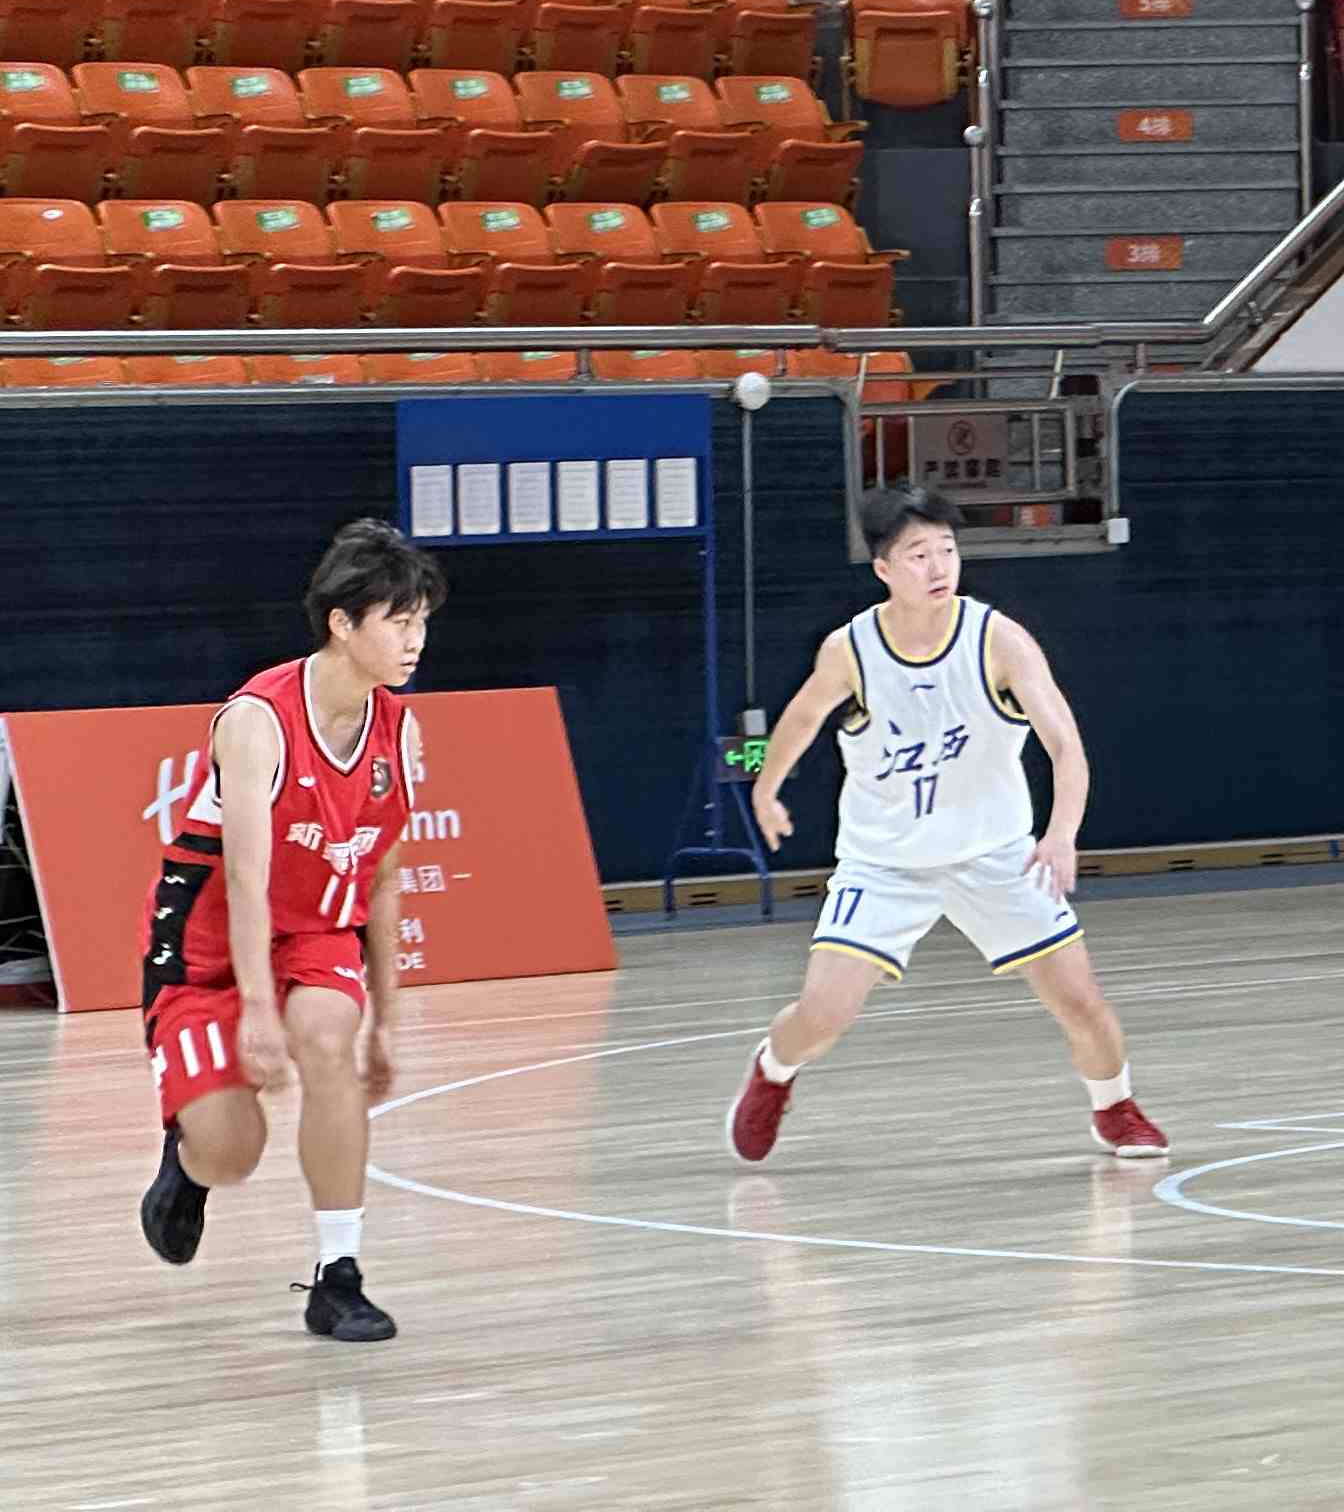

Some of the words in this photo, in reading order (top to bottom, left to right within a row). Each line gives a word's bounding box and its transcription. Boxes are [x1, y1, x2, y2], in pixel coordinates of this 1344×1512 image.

[913, 773, 939, 820] 17
[318, 875, 357, 929] 11
[831, 887, 864, 927] 17
[178, 1020, 227, 1078] 11
